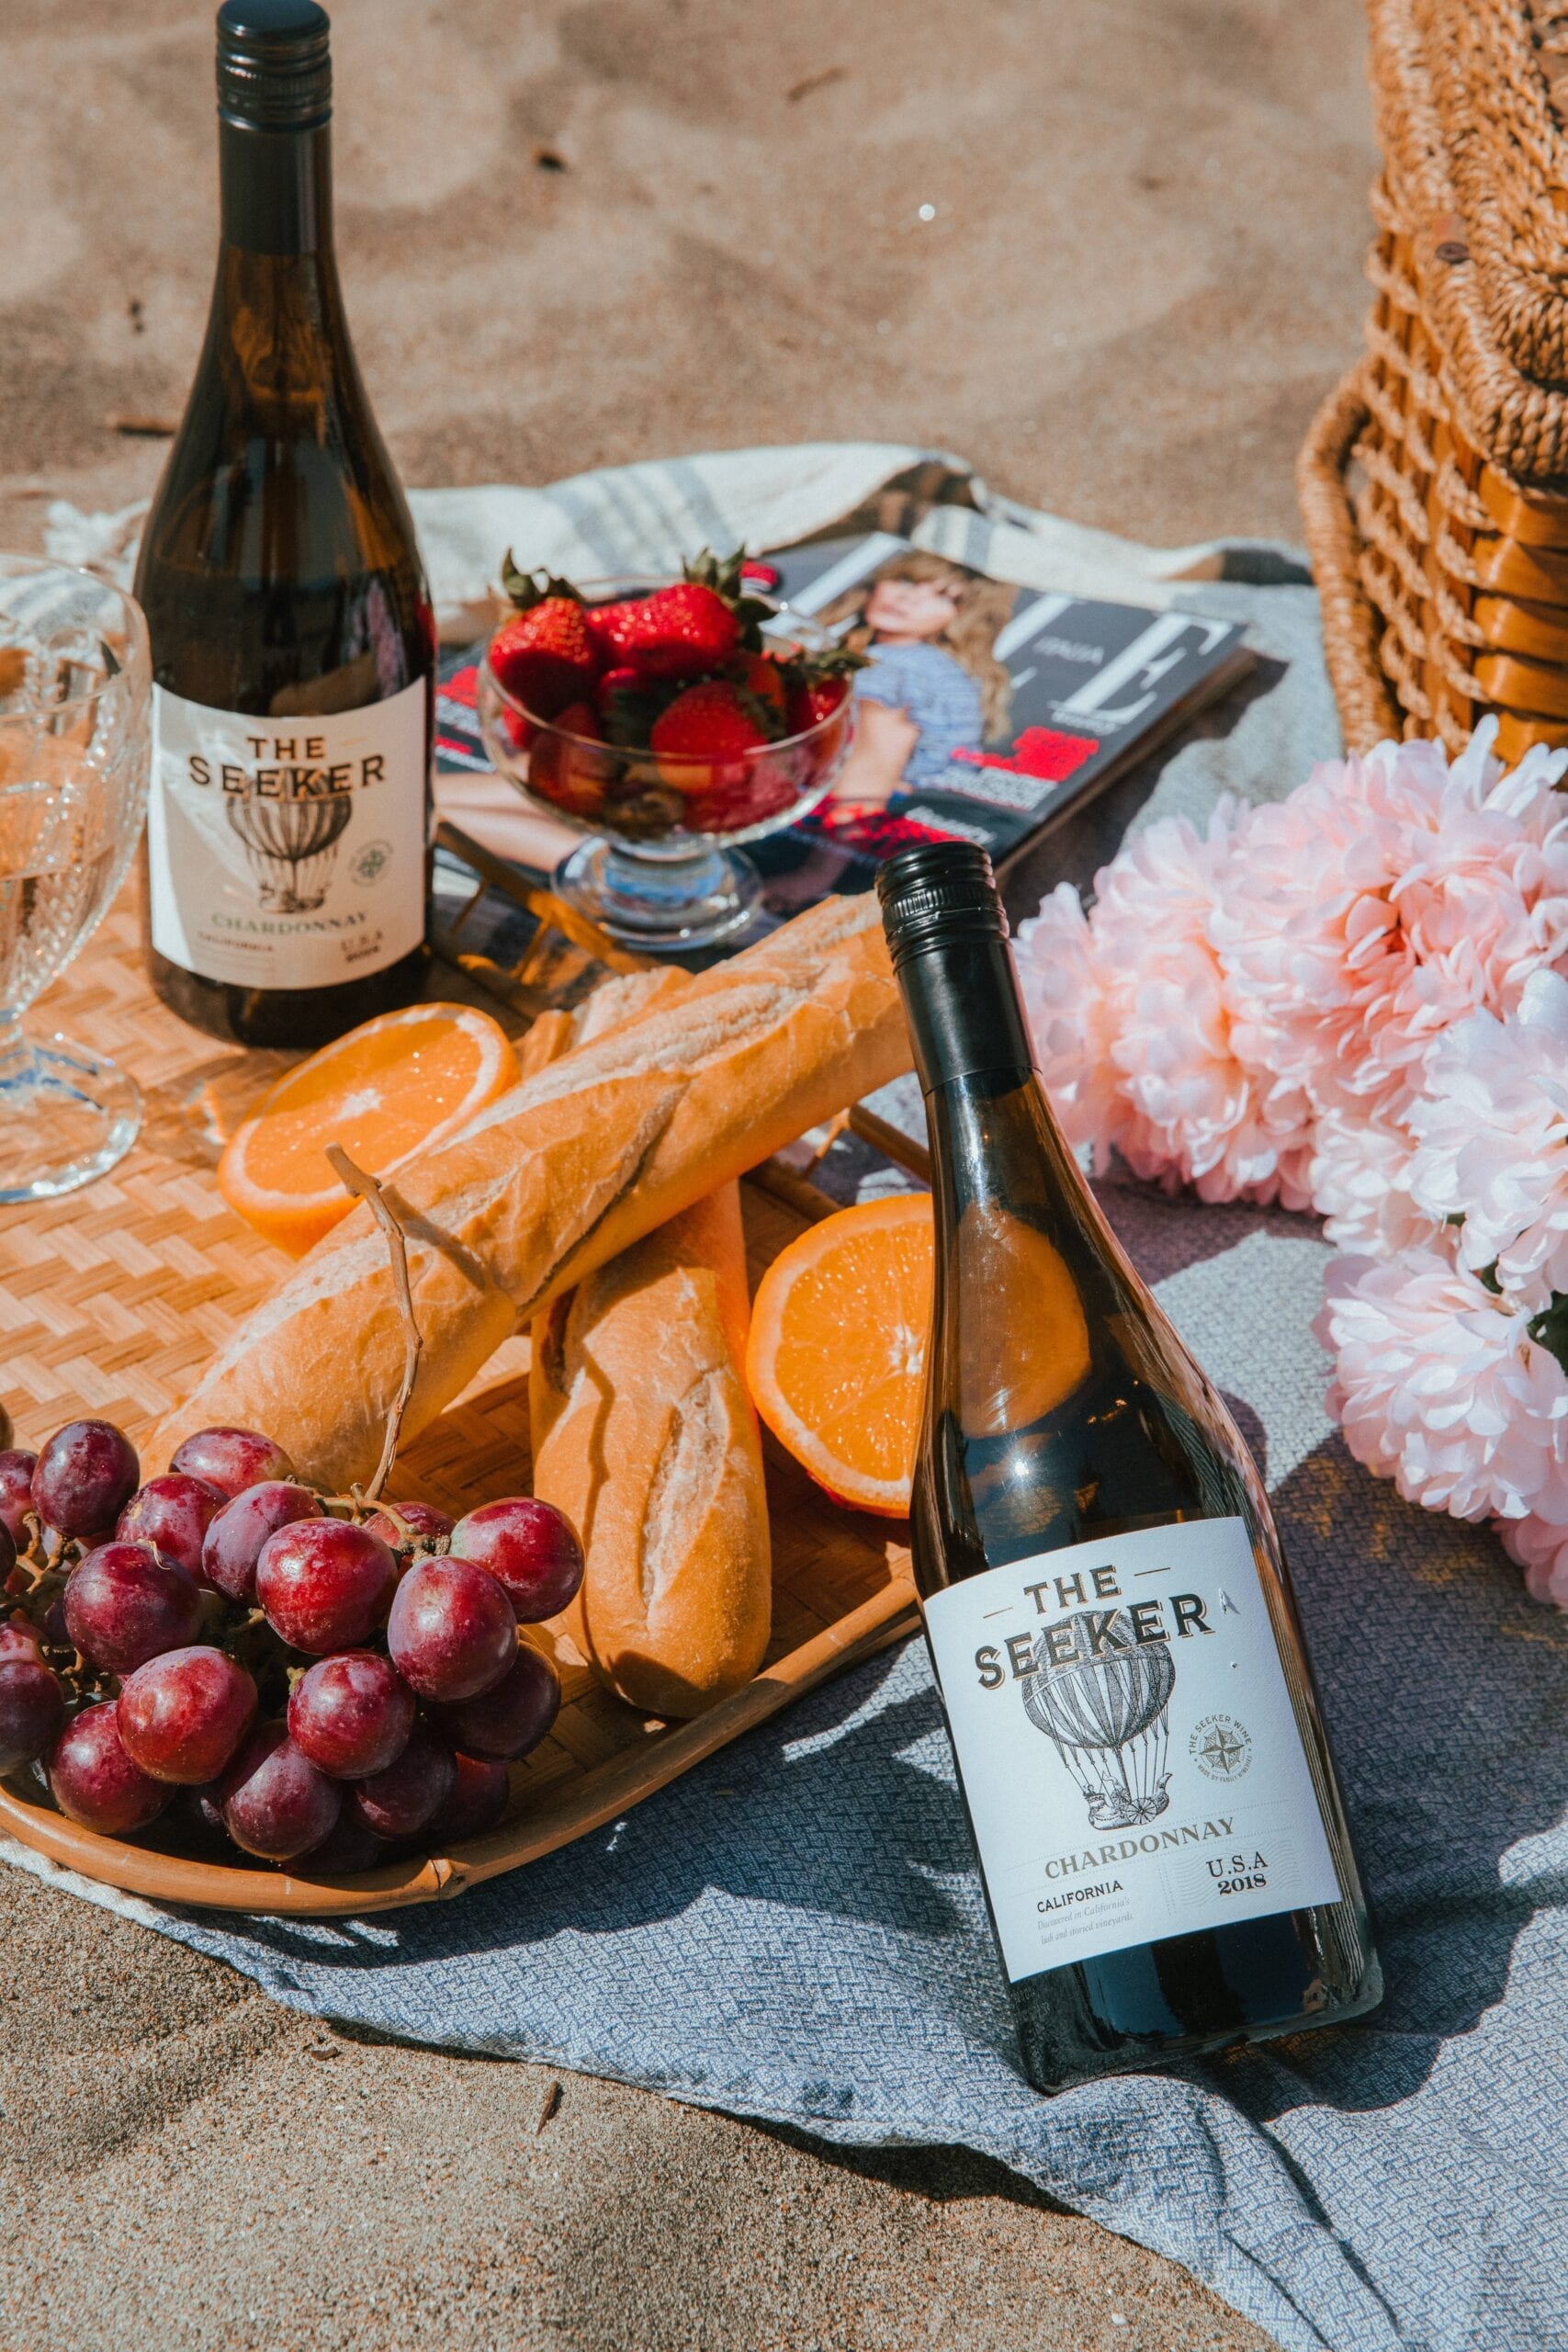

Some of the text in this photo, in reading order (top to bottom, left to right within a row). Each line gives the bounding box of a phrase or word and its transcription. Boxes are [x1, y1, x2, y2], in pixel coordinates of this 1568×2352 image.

[247, 737, 325, 760] THE
[189, 754, 385, 798] SEEKER
[1023, 1564, 1122, 1615] THE
[975, 1593, 1215, 1690] SEEKER
[1189, 1714, 1252, 1756] THE SEEKER WINE
[1044, 1816, 1235, 1880] CHARDONNAY
[1037, 1880, 1123, 1913] CALIFORNIA
[1217, 1872, 1268, 1895] 2018
[1074, 1910, 1082, 1919] in
[1055, 1928, 1067, 1940] and
